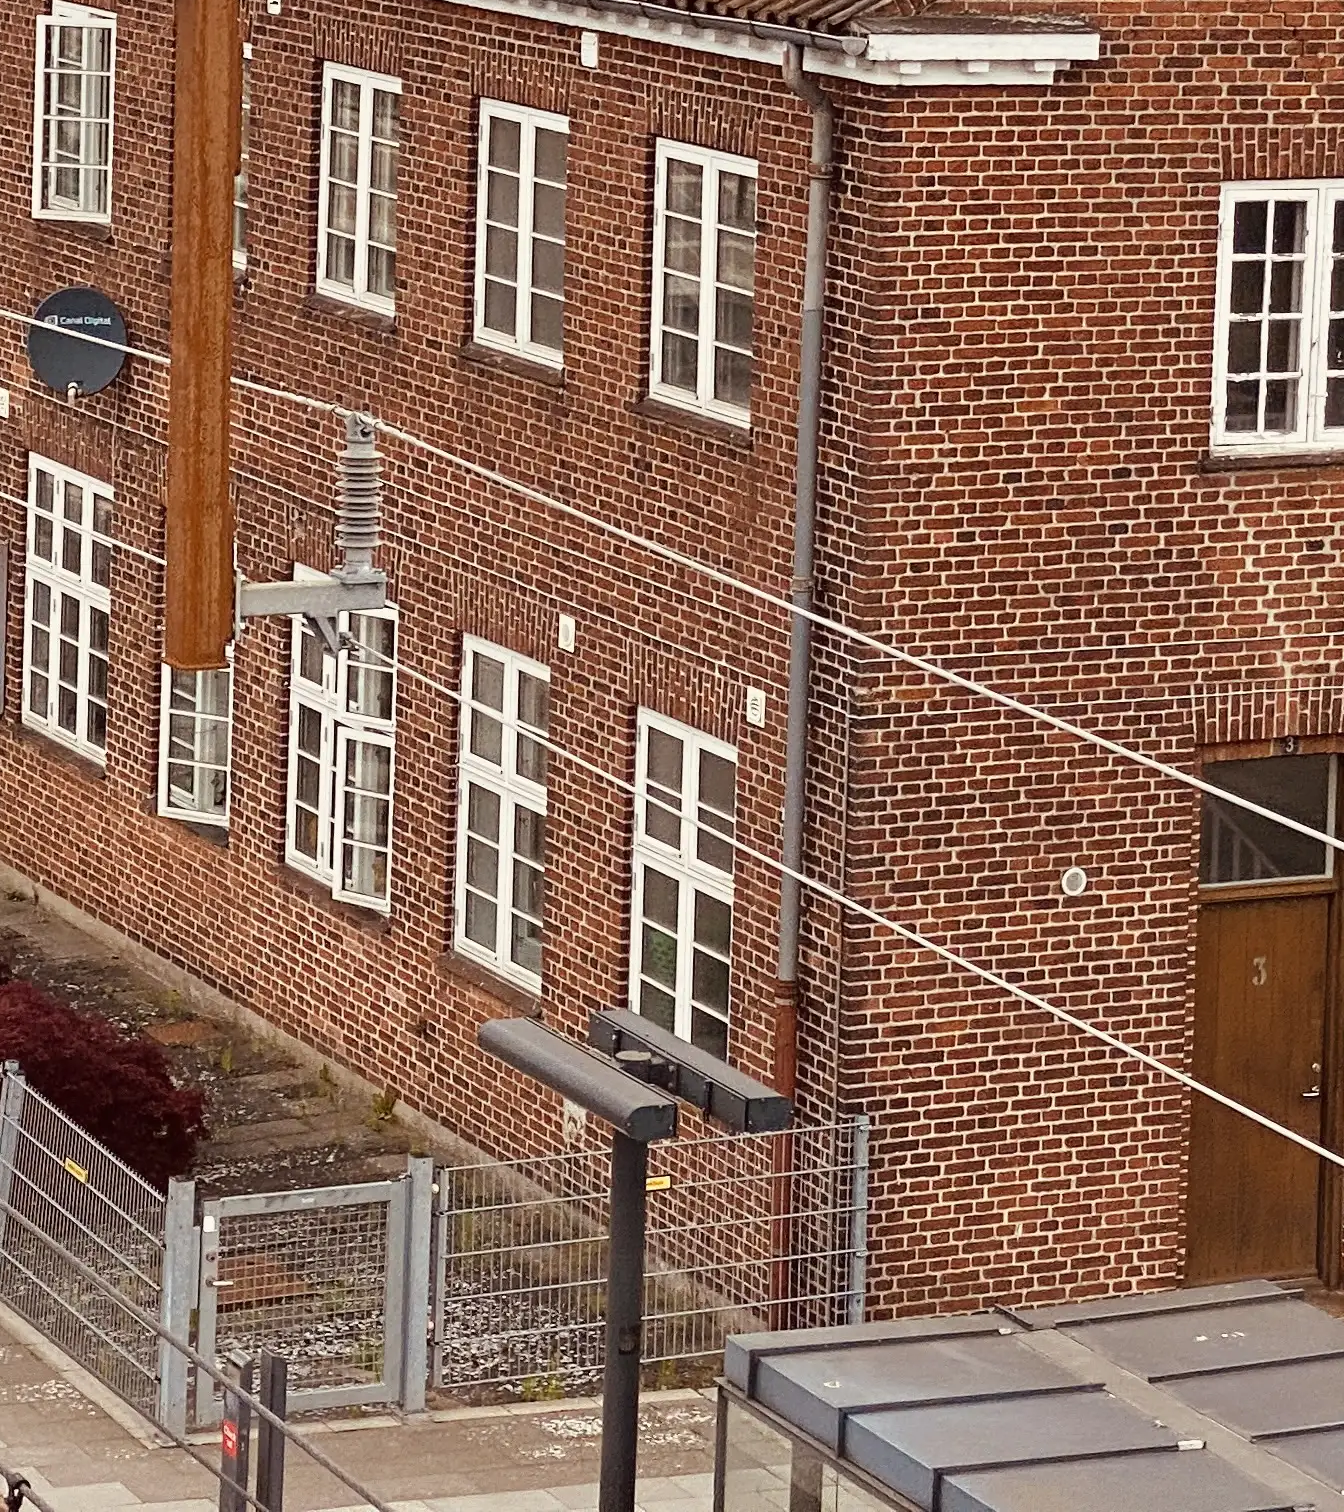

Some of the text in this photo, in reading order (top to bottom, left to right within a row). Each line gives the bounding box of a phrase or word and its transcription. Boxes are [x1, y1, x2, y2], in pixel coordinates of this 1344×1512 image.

[60, 316, 111, 326] Canal Digital
[1285, 736, 1295, 753] 3
[1251, 955, 1268, 986] 3
